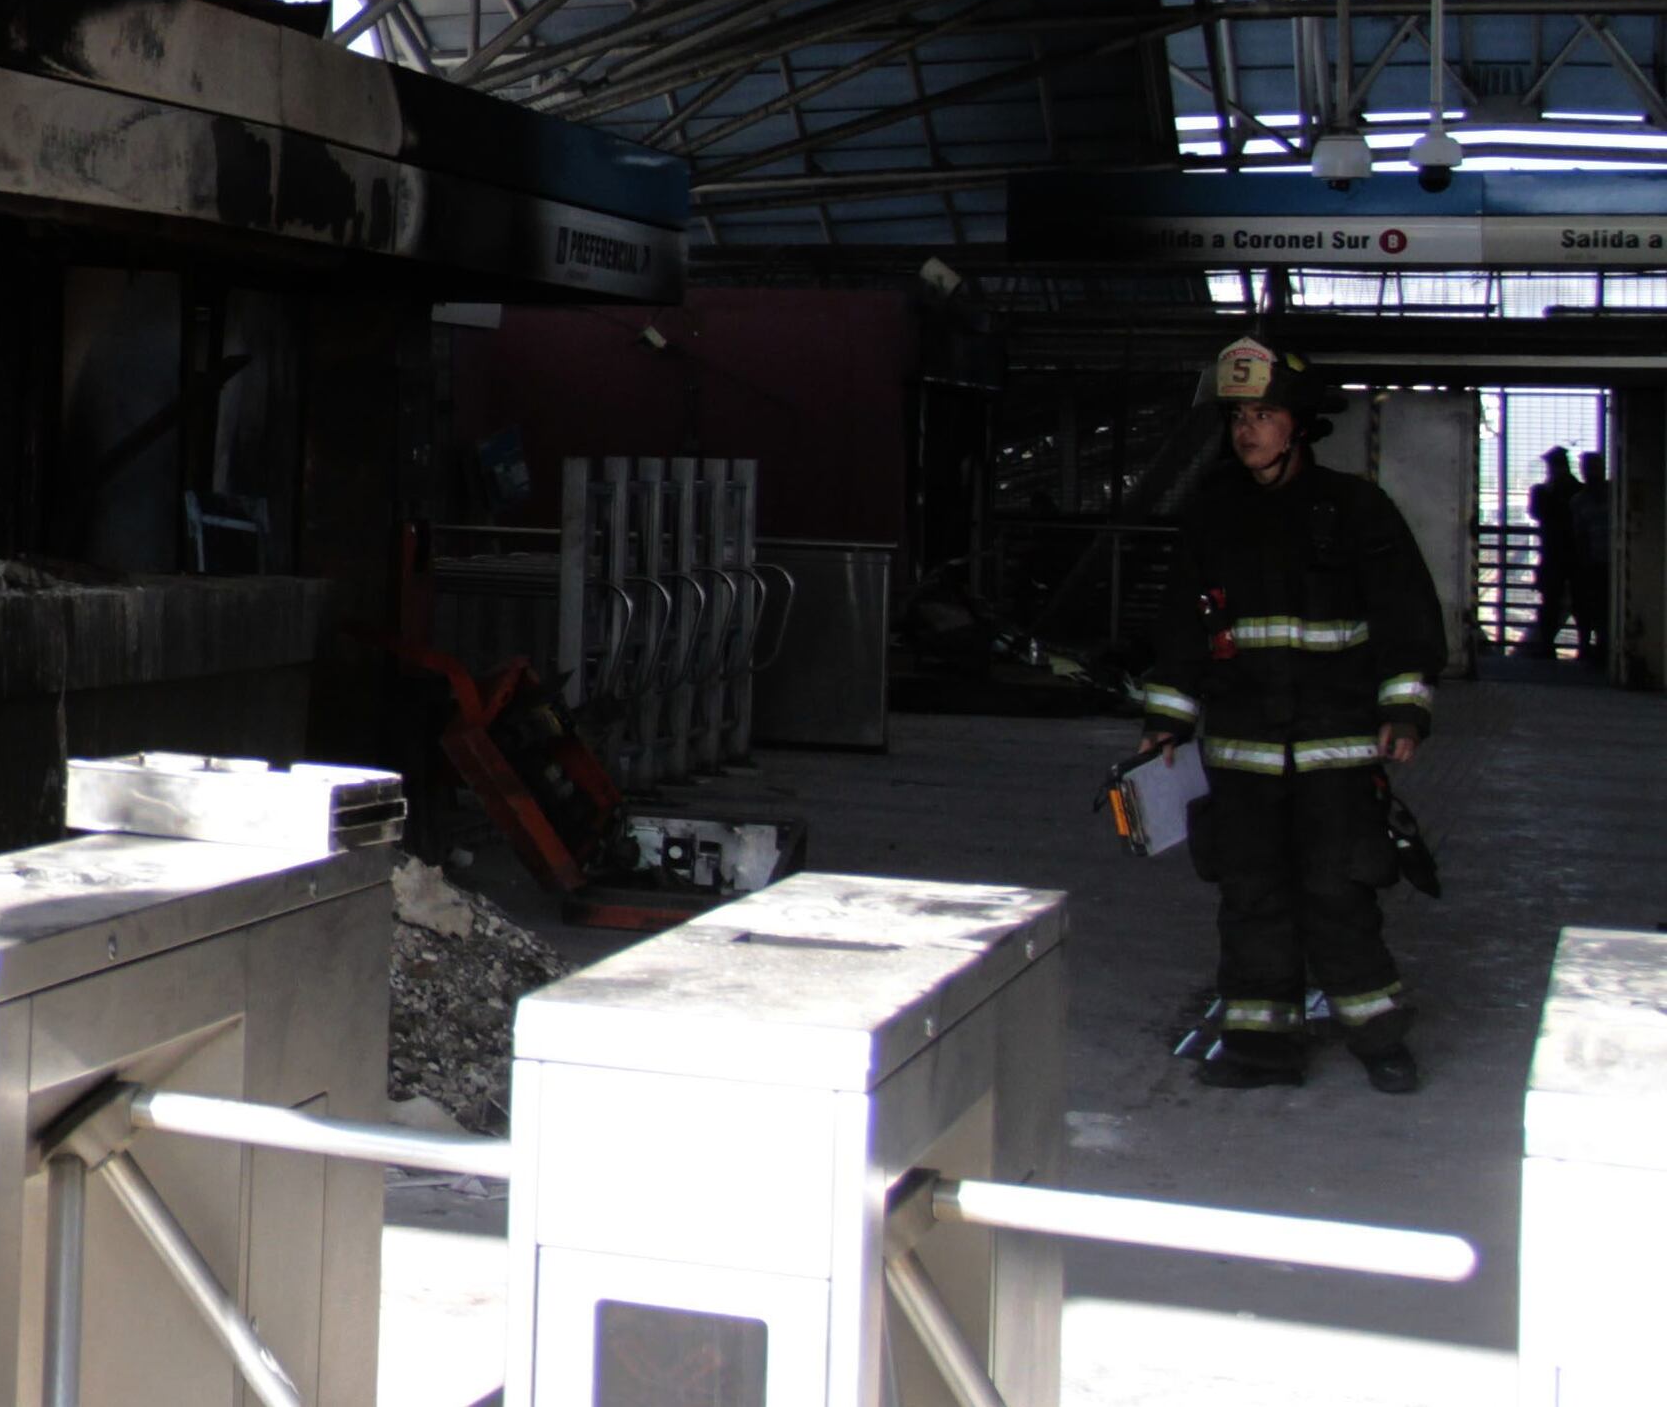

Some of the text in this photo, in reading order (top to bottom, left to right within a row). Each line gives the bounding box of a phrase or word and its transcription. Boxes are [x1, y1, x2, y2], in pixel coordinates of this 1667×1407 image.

[1213, 234, 1226, 249] a
[1233, 230, 1323, 250] Coronel
[1331, 230, 1371, 250] Sur
[1561, 229, 1663, 249] Salida a
[1233, 358, 1253, 384] 5
